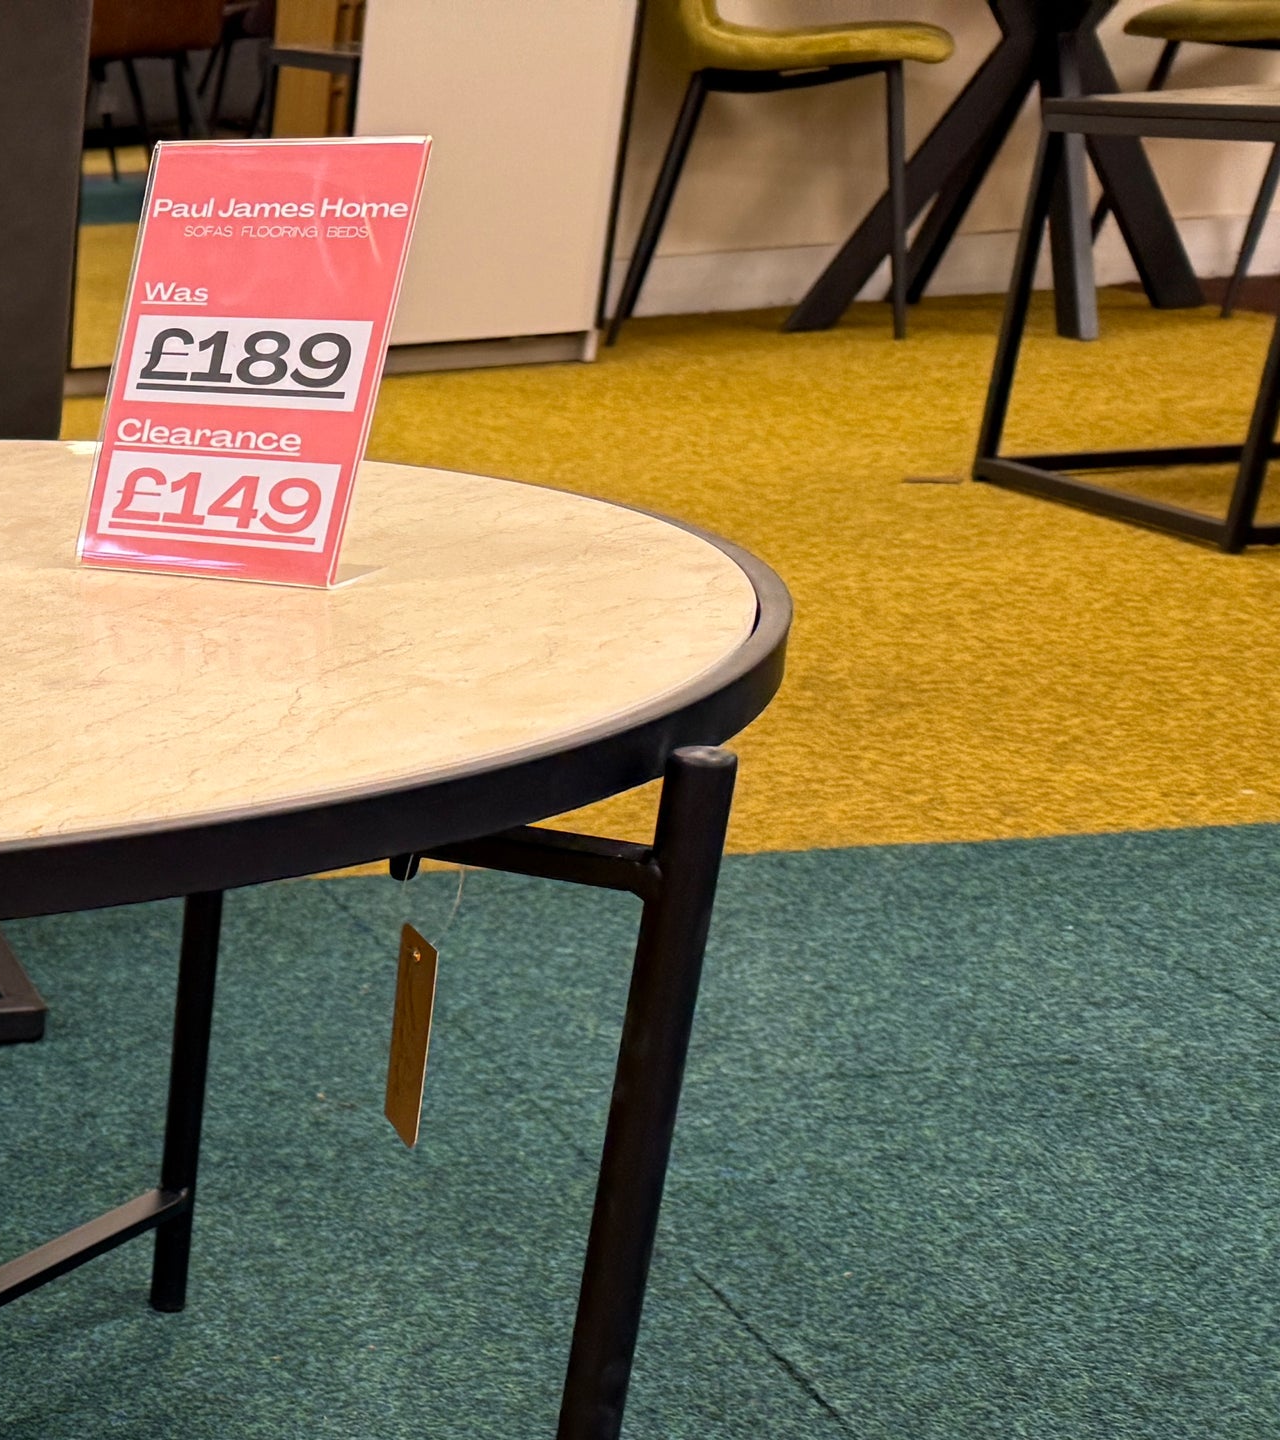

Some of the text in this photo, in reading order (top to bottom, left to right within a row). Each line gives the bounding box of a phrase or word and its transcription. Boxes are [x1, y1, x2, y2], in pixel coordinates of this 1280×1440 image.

[152, 198, 409, 219] Paul James Home
[183, 225, 370, 238] SOFAS FLOORING BEDS
[144, 281, 209, 302] Was
[138, 327, 353, 387] £189
[116, 418, 302, 453] Clearance
[110, 467, 322, 535] £149
